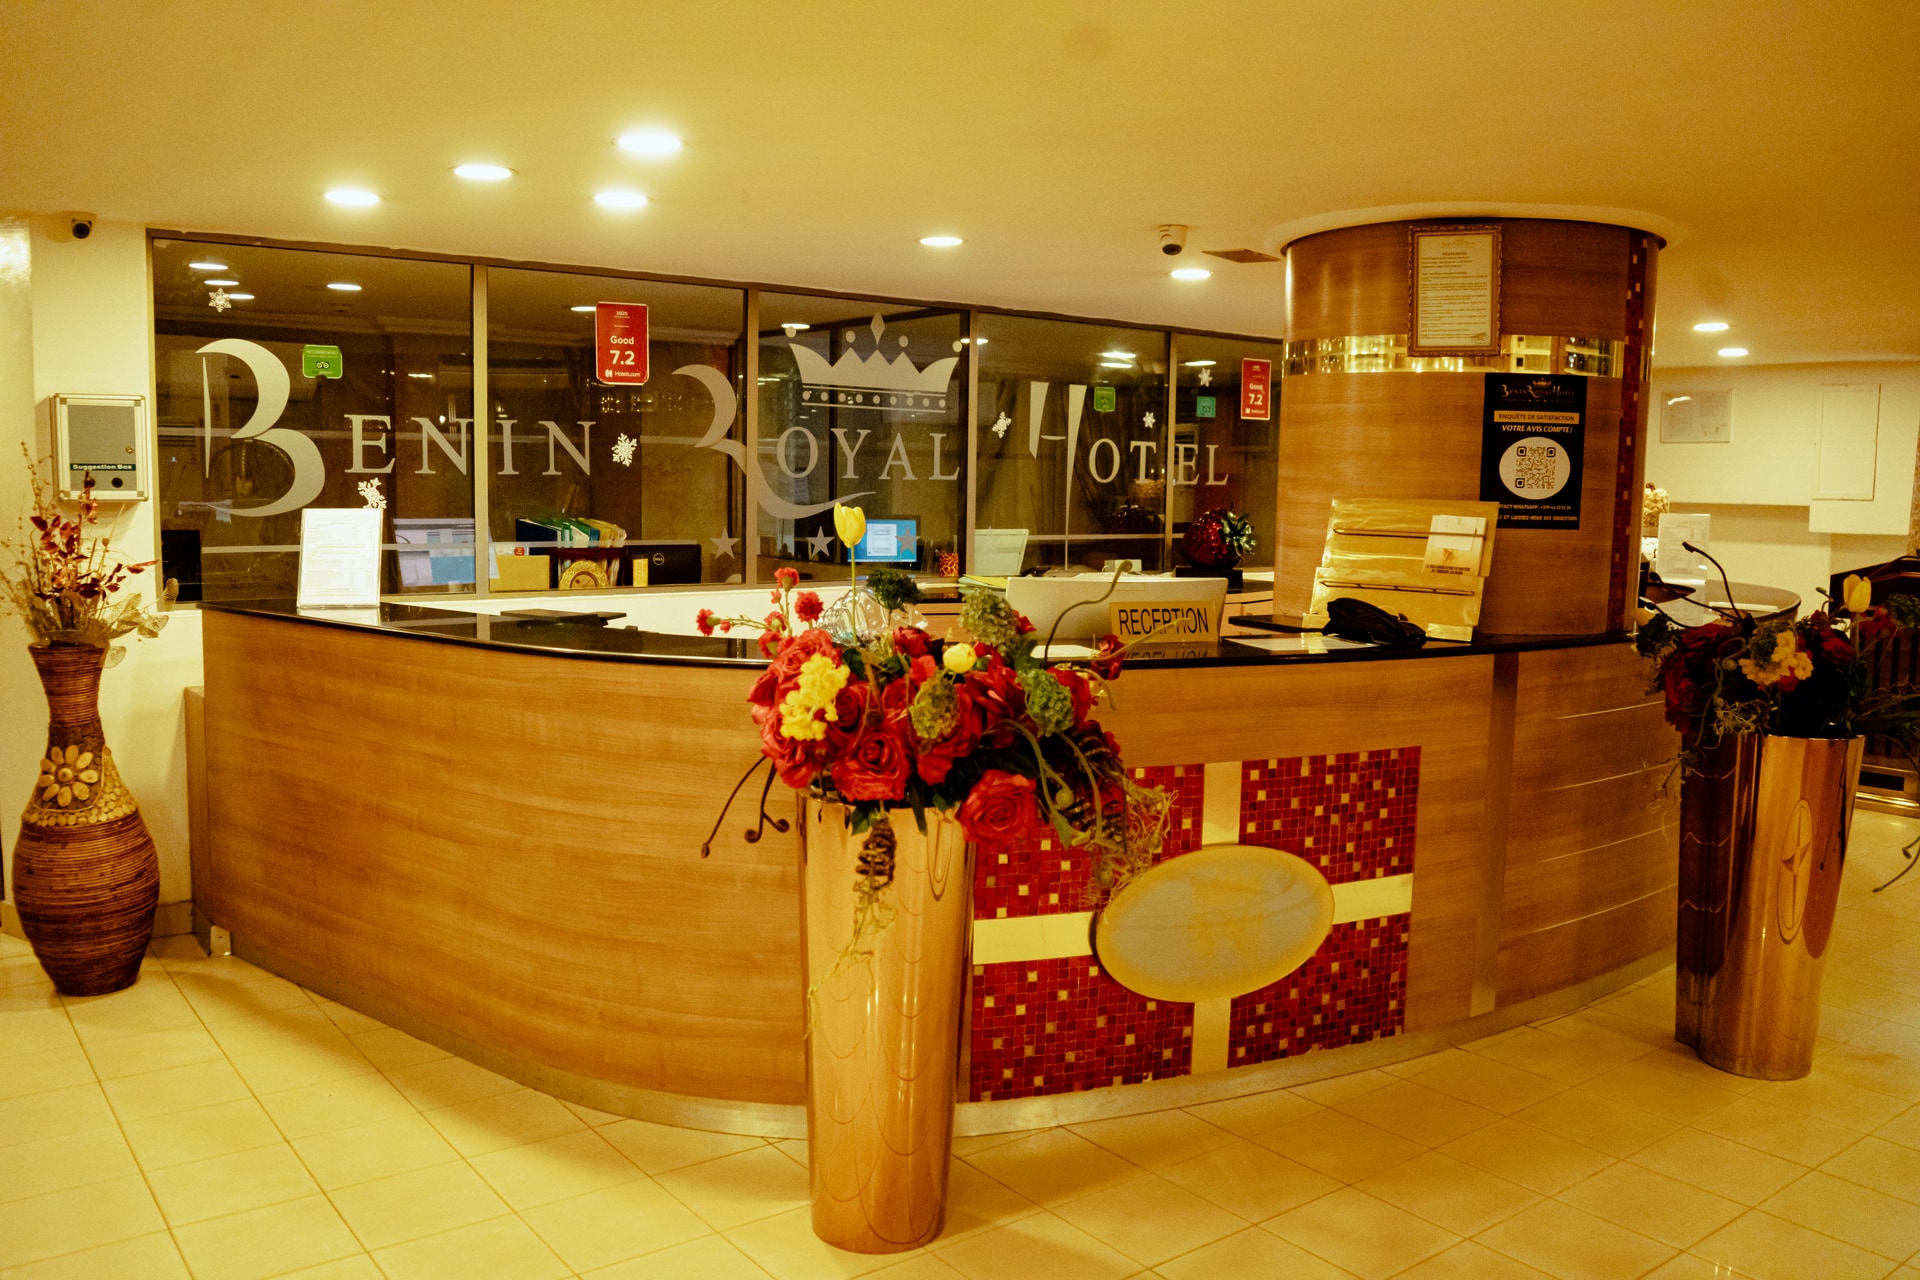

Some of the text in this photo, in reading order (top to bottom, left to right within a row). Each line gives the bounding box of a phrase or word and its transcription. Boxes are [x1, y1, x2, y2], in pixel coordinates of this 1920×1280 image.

[610, 335, 635, 345] Good
[609, 349, 635, 365] 7.2
[1248, 393, 1263, 405] 7.2
[1502, 424, 1526, 432] VOTRE
[195, 338, 1229, 572] BENIN ROYAL HOTEL
[1118, 607, 1209, 635] RECEPTION
